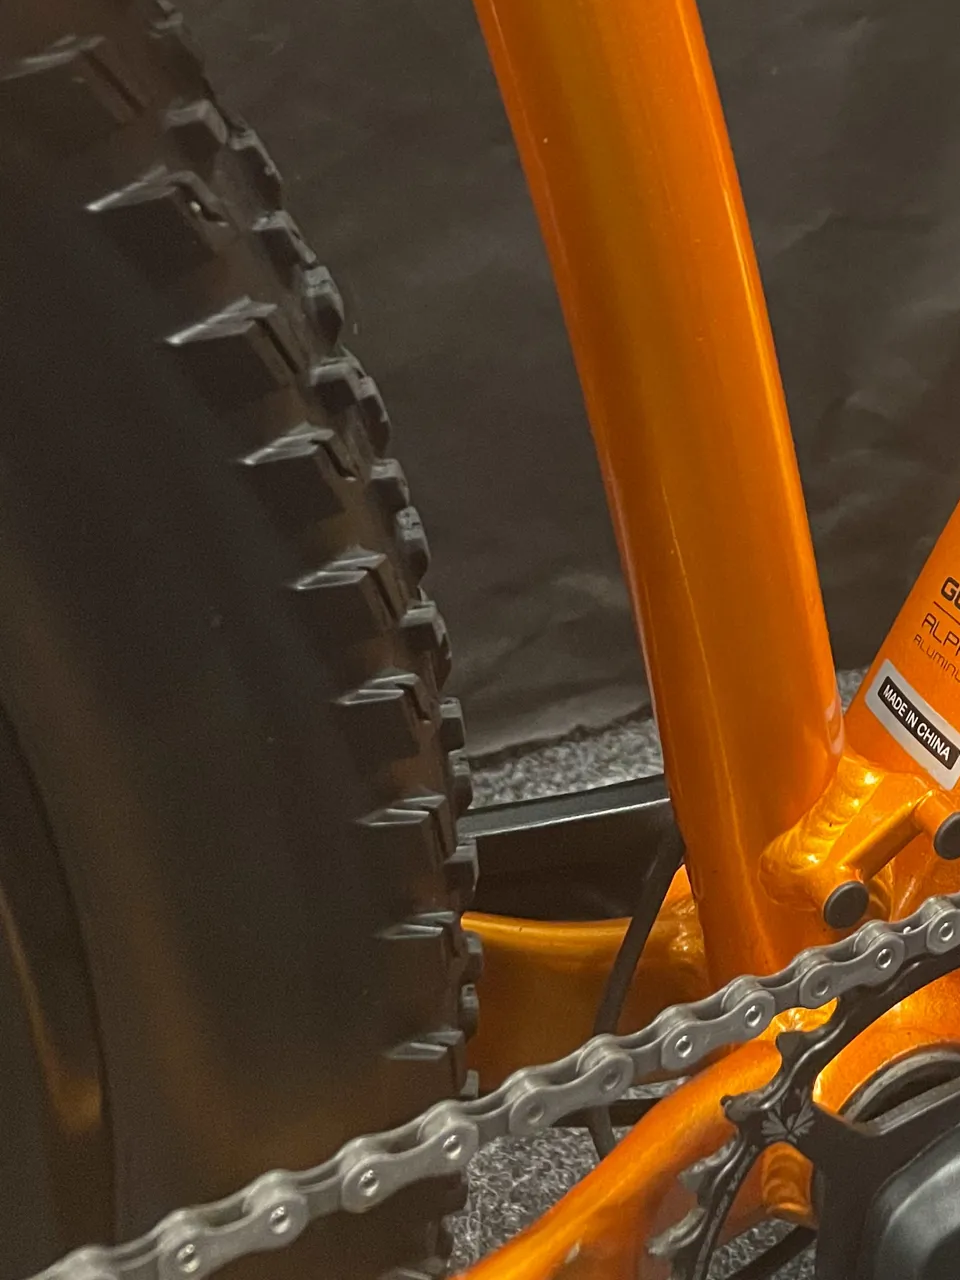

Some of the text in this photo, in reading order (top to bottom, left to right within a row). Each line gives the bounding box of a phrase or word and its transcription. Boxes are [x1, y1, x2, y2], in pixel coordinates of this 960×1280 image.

[883, 684, 951, 762] MADE IN CHINA
